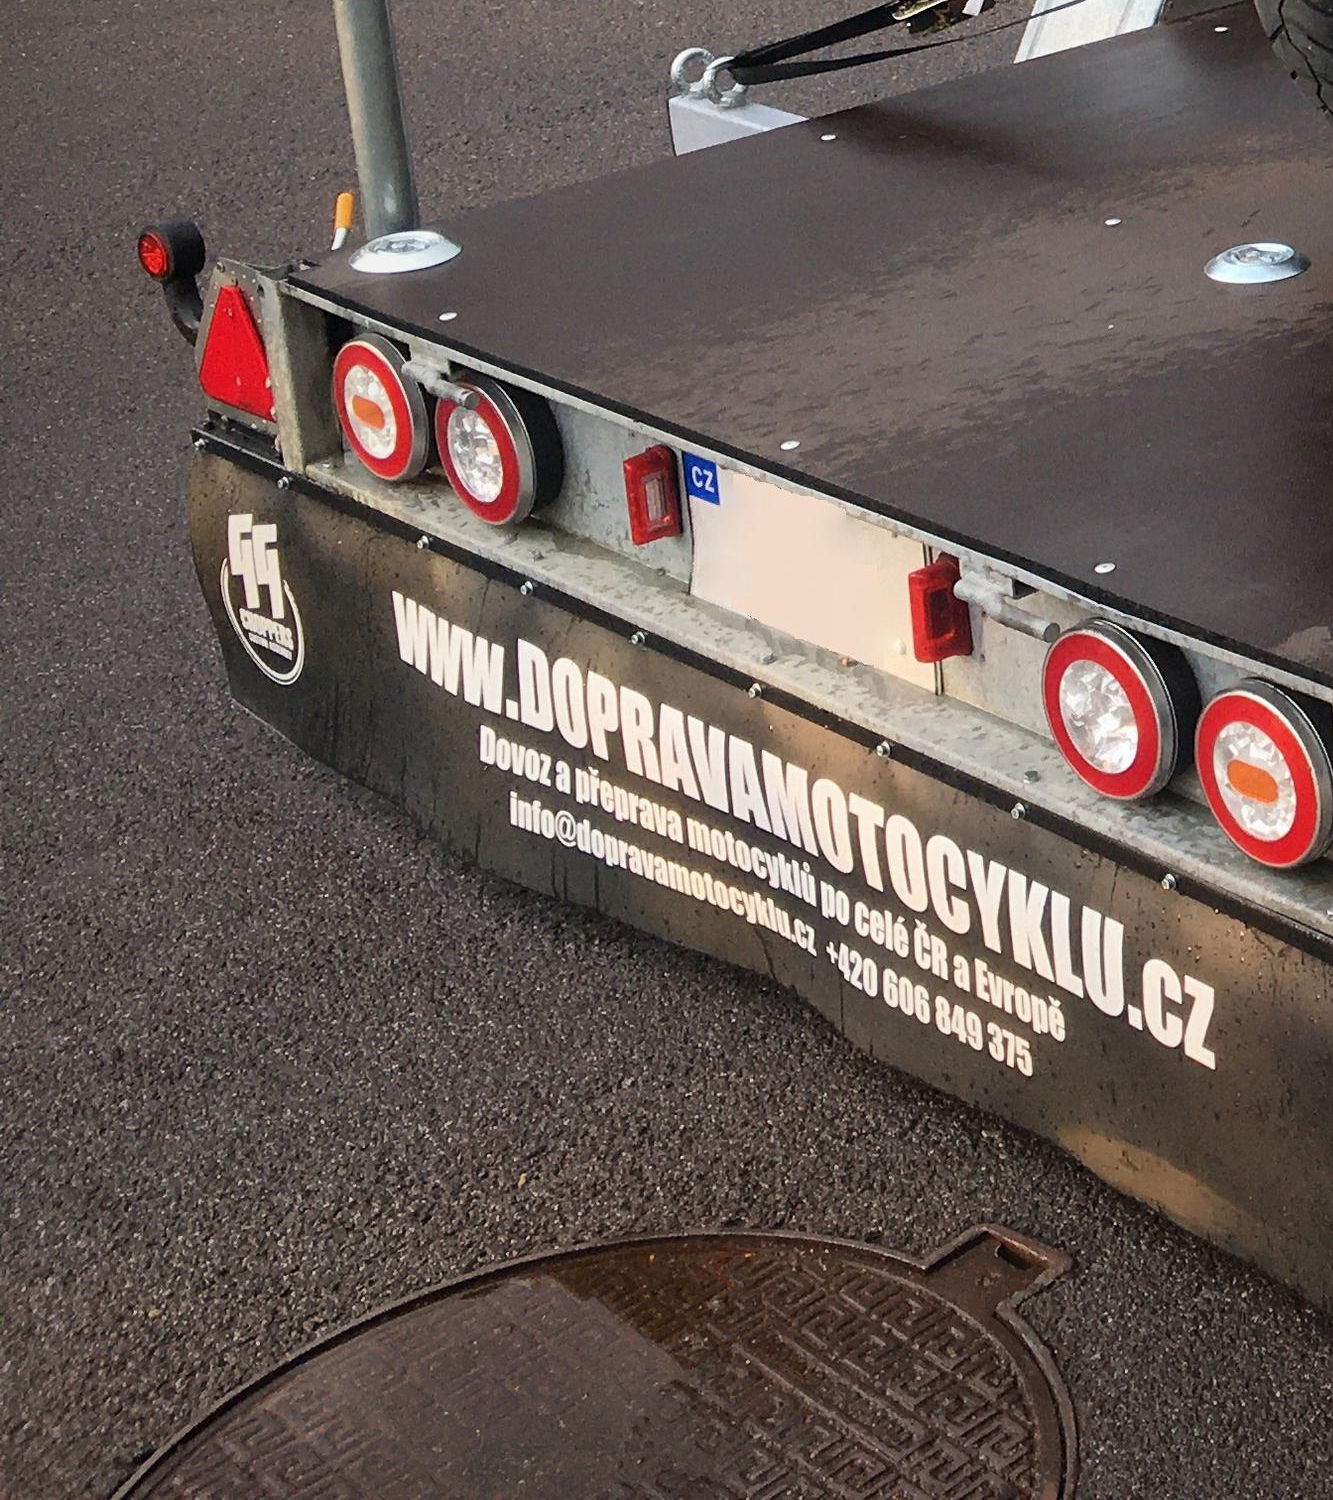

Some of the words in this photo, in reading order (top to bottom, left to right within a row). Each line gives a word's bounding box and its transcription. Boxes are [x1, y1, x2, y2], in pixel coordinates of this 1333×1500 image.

[691, 465, 715, 493] CZ
[479, 724, 552, 787] Dovoz
[555, 763, 571, 794] a
[575, 766, 684, 844] přeprava
[686, 816, 817, 908] motocyklů
[820, 879, 850, 927] po
[853, 901, 910, 959] celé
[912, 918, 949, 981] ČR
[953, 955, 971, 991] a
[974, 956, 1066, 1043] Evropě
[509, 790, 817, 957] info@dopravamotocyklu.cz
[825, 940, 878, 998] +420
[883, 967, 931, 1025] 606
[935, 988, 984, 1052] 849
[986, 1022, 1033, 1078] 375
